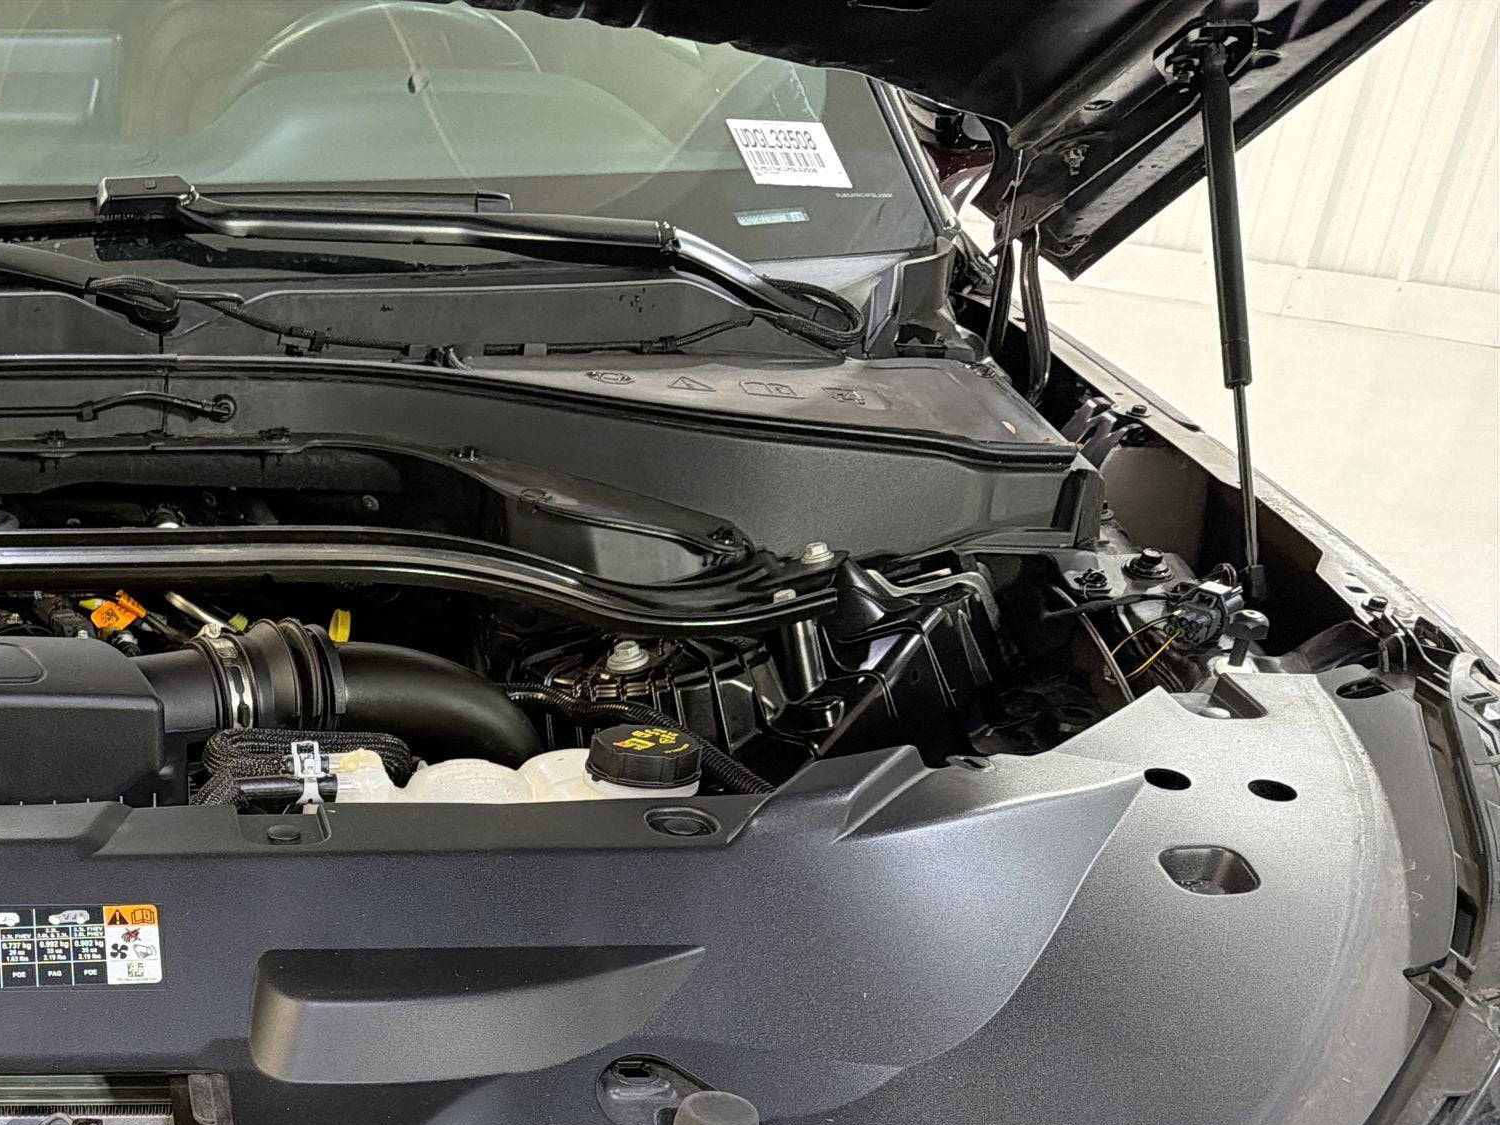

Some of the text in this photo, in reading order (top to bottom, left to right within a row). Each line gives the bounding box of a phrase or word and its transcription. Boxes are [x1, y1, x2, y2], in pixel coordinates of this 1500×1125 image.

[734, 128, 818, 151] UDGL33508
[22, 942, 32, 950] kg
[60, 940, 69, 949] kg
[94, 939, 104, 948] kg
